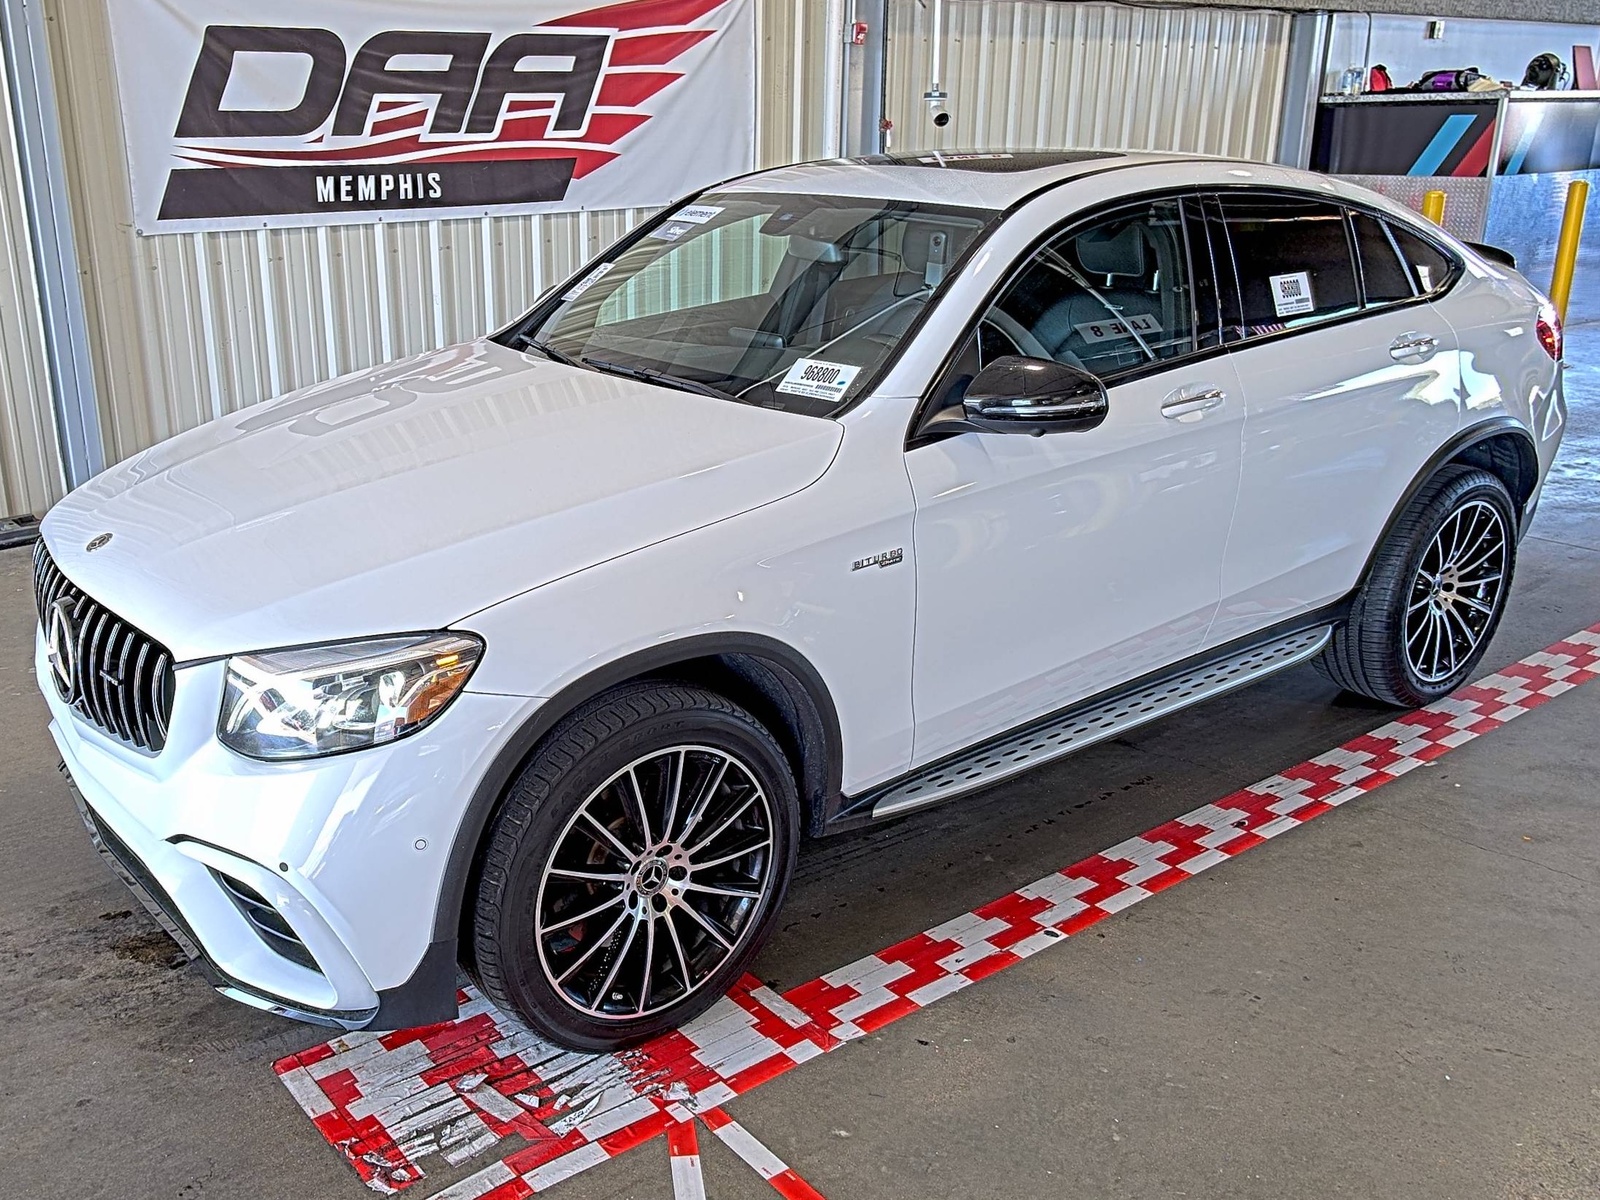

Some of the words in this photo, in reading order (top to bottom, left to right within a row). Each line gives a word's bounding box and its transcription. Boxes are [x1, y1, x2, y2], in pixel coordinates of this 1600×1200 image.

[174, 25, 609, 139] DAA
[315, 172, 443, 203] MEMPHIS
[801, 365, 840, 384] 968800
[852, 547, 904, 571] BITURBO
